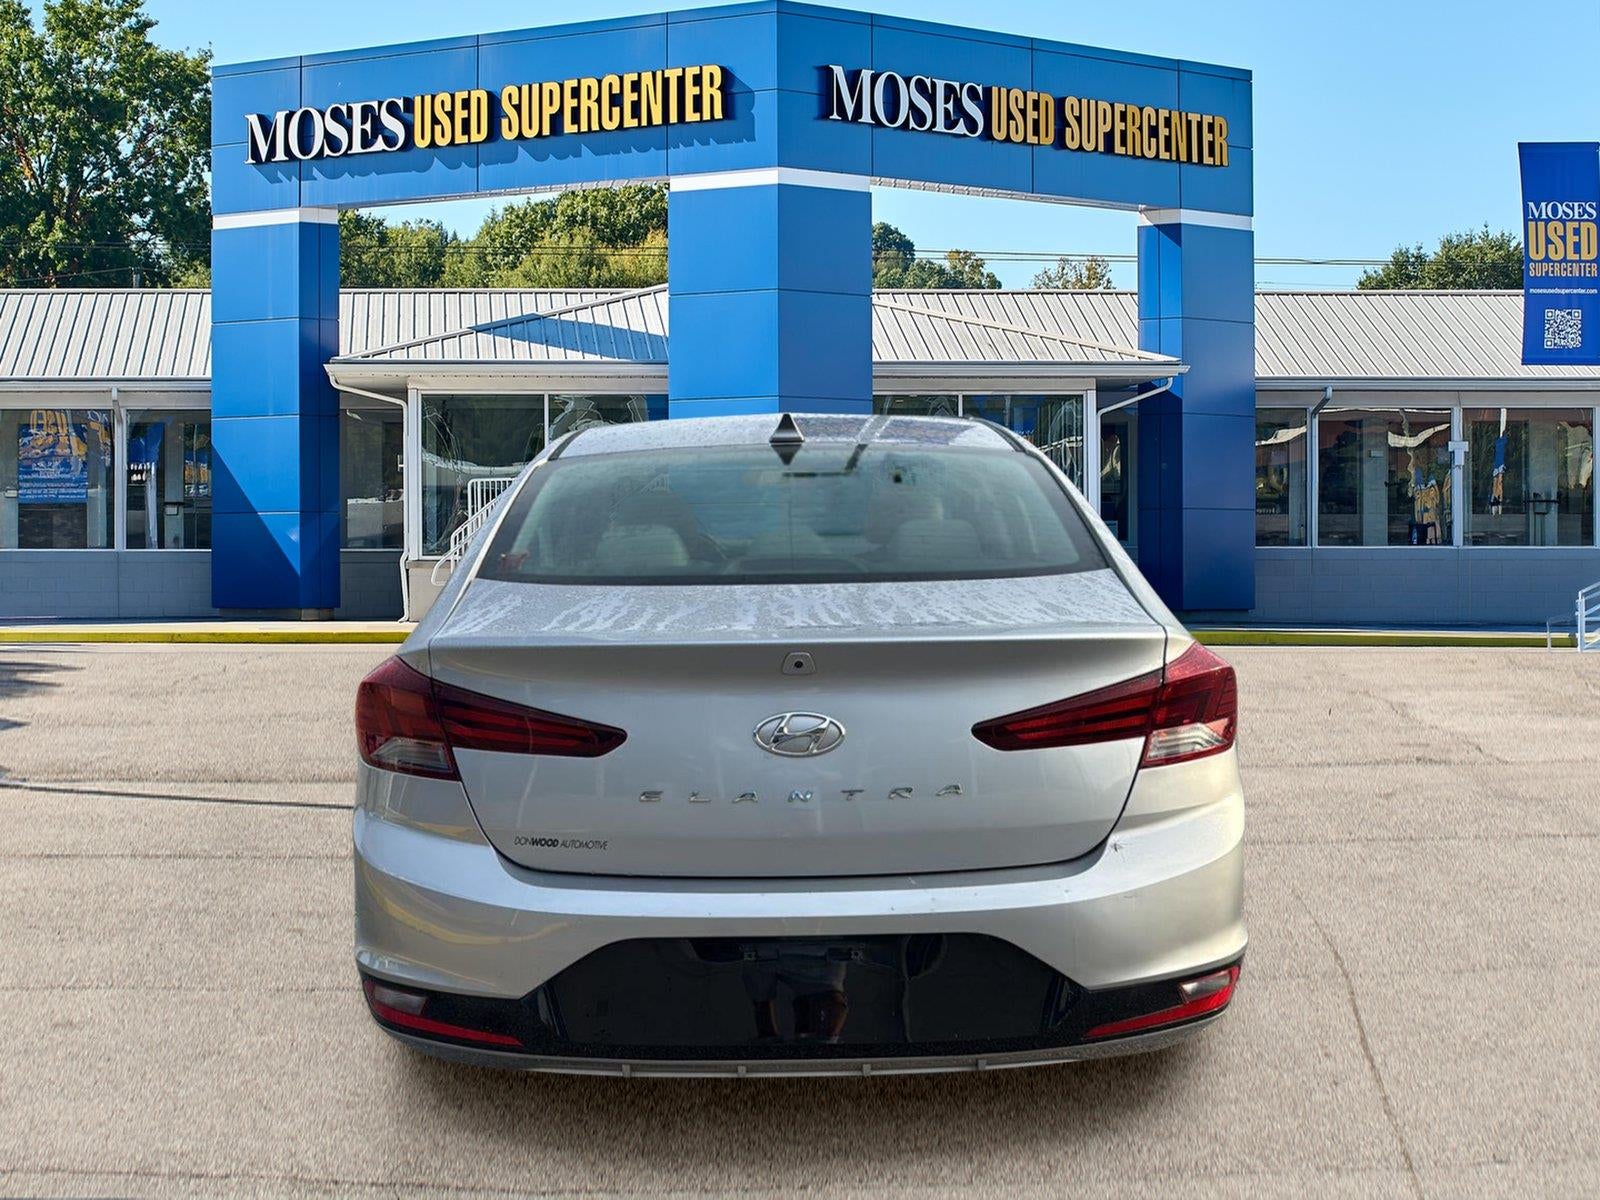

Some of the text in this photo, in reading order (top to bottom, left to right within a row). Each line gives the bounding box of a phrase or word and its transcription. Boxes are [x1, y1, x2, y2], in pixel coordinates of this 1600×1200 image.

[245, 64, 723, 164] MOSES USED SUPERCENTER
[828, 64, 1230, 167] MOSES USED SUPERCENTER
[1527, 201, 1597, 219] MOSES
[1528, 221, 1598, 260] USED
[1529, 262, 1598, 277] SUPERCENTER
[639, 783, 964, 803] ELANTRA
[514, 836, 608, 850] DONWOOD AUTOMOTIVE
